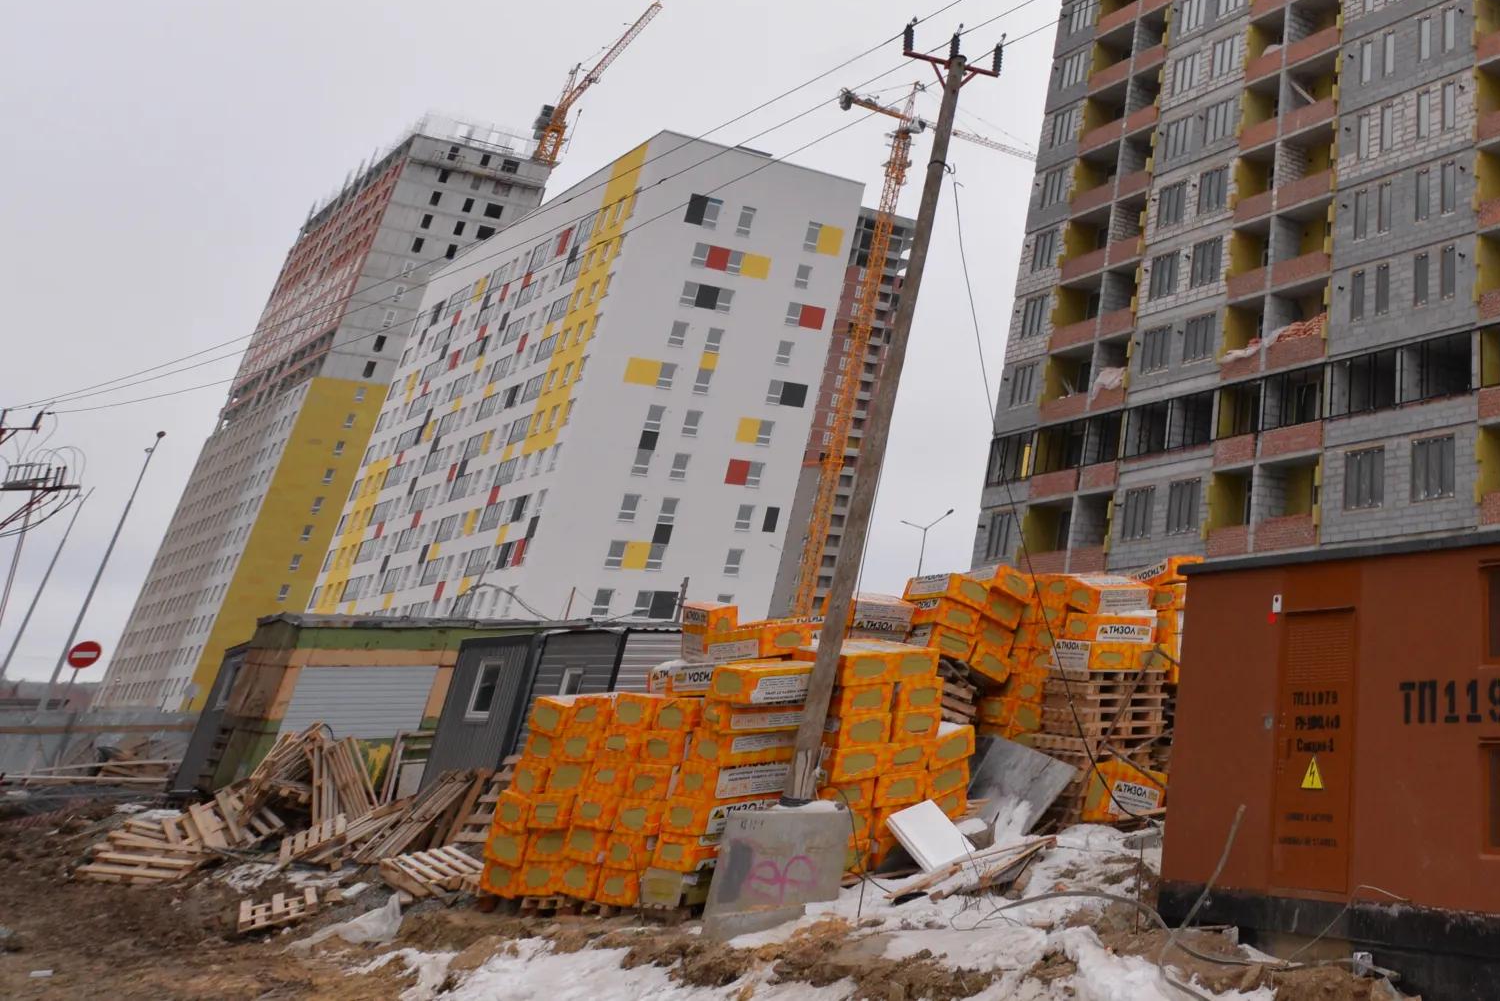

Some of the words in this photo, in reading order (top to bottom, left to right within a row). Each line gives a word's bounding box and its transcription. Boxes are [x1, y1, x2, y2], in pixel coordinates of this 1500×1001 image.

[1138, 568, 1160, 580] ТИЗОЛ
[865, 620, 893, 631] ТИЗОЛ
[1109, 625, 1136, 635] ТИЗОЛ
[1061, 641, 1080, 650] ТИЗОЛ
[1123, 783, 1147, 798] ТИЗОЛ
